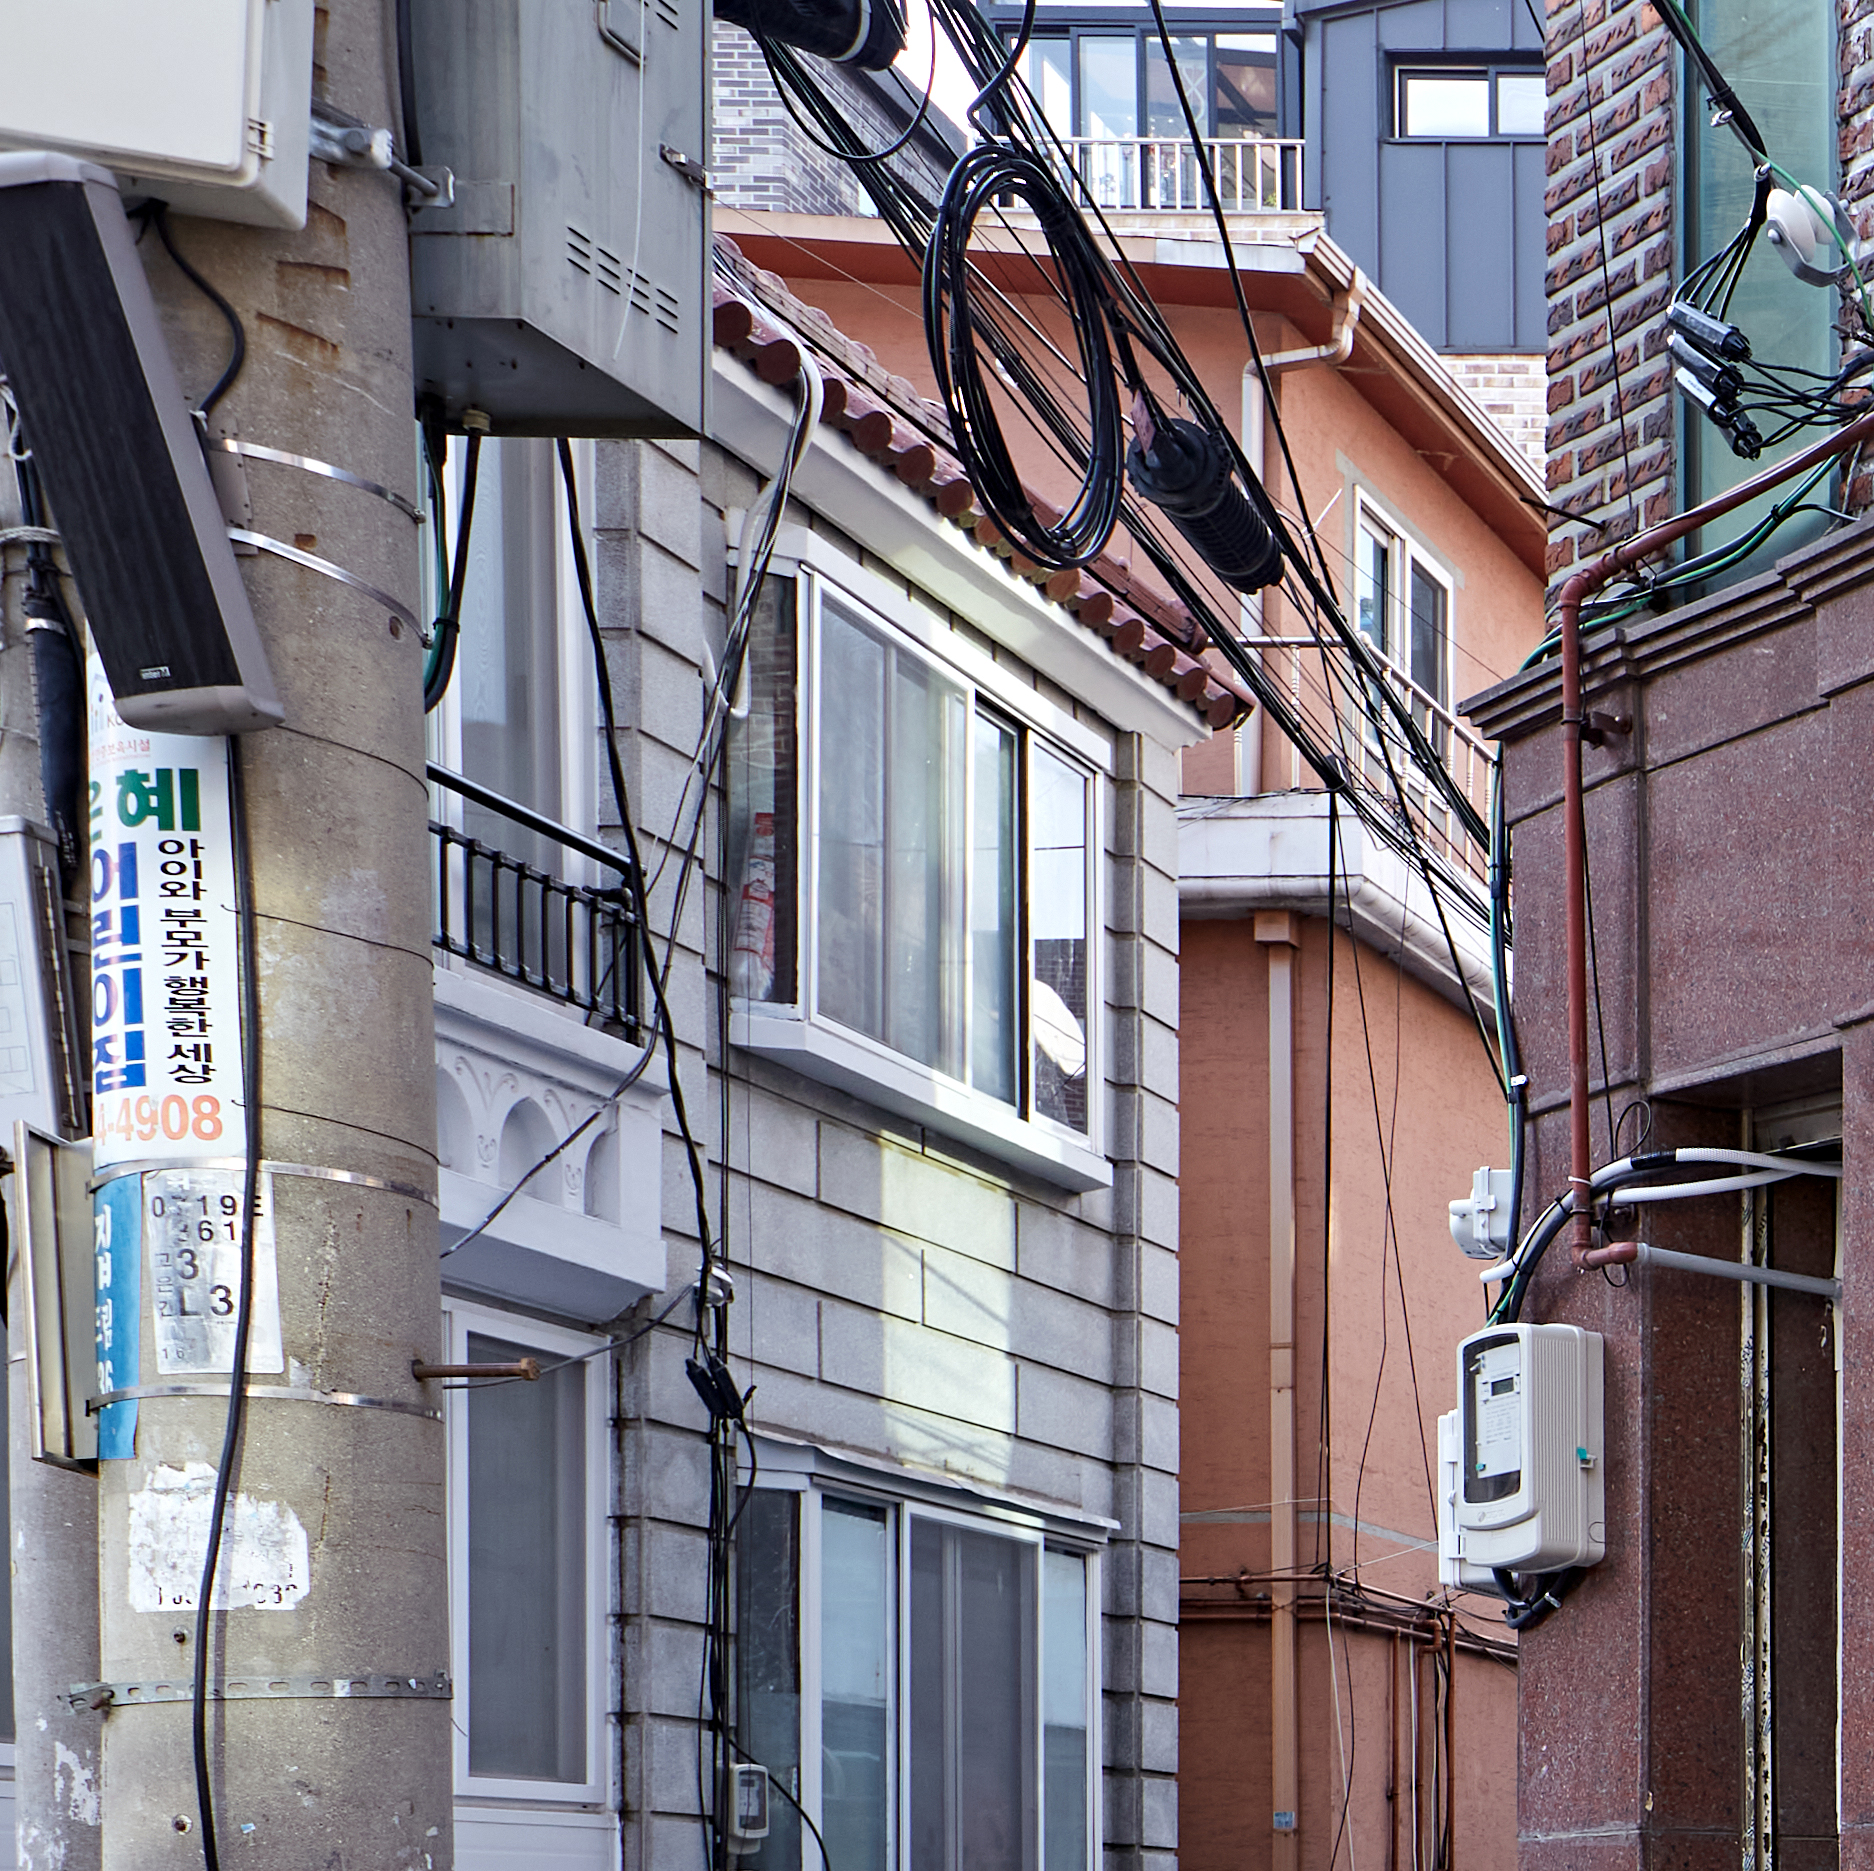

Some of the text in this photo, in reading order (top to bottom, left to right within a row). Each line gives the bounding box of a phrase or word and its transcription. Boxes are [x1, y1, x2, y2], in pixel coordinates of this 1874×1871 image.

[158, 838, 217, 1084] 아이와 부모가 행복한 세상
